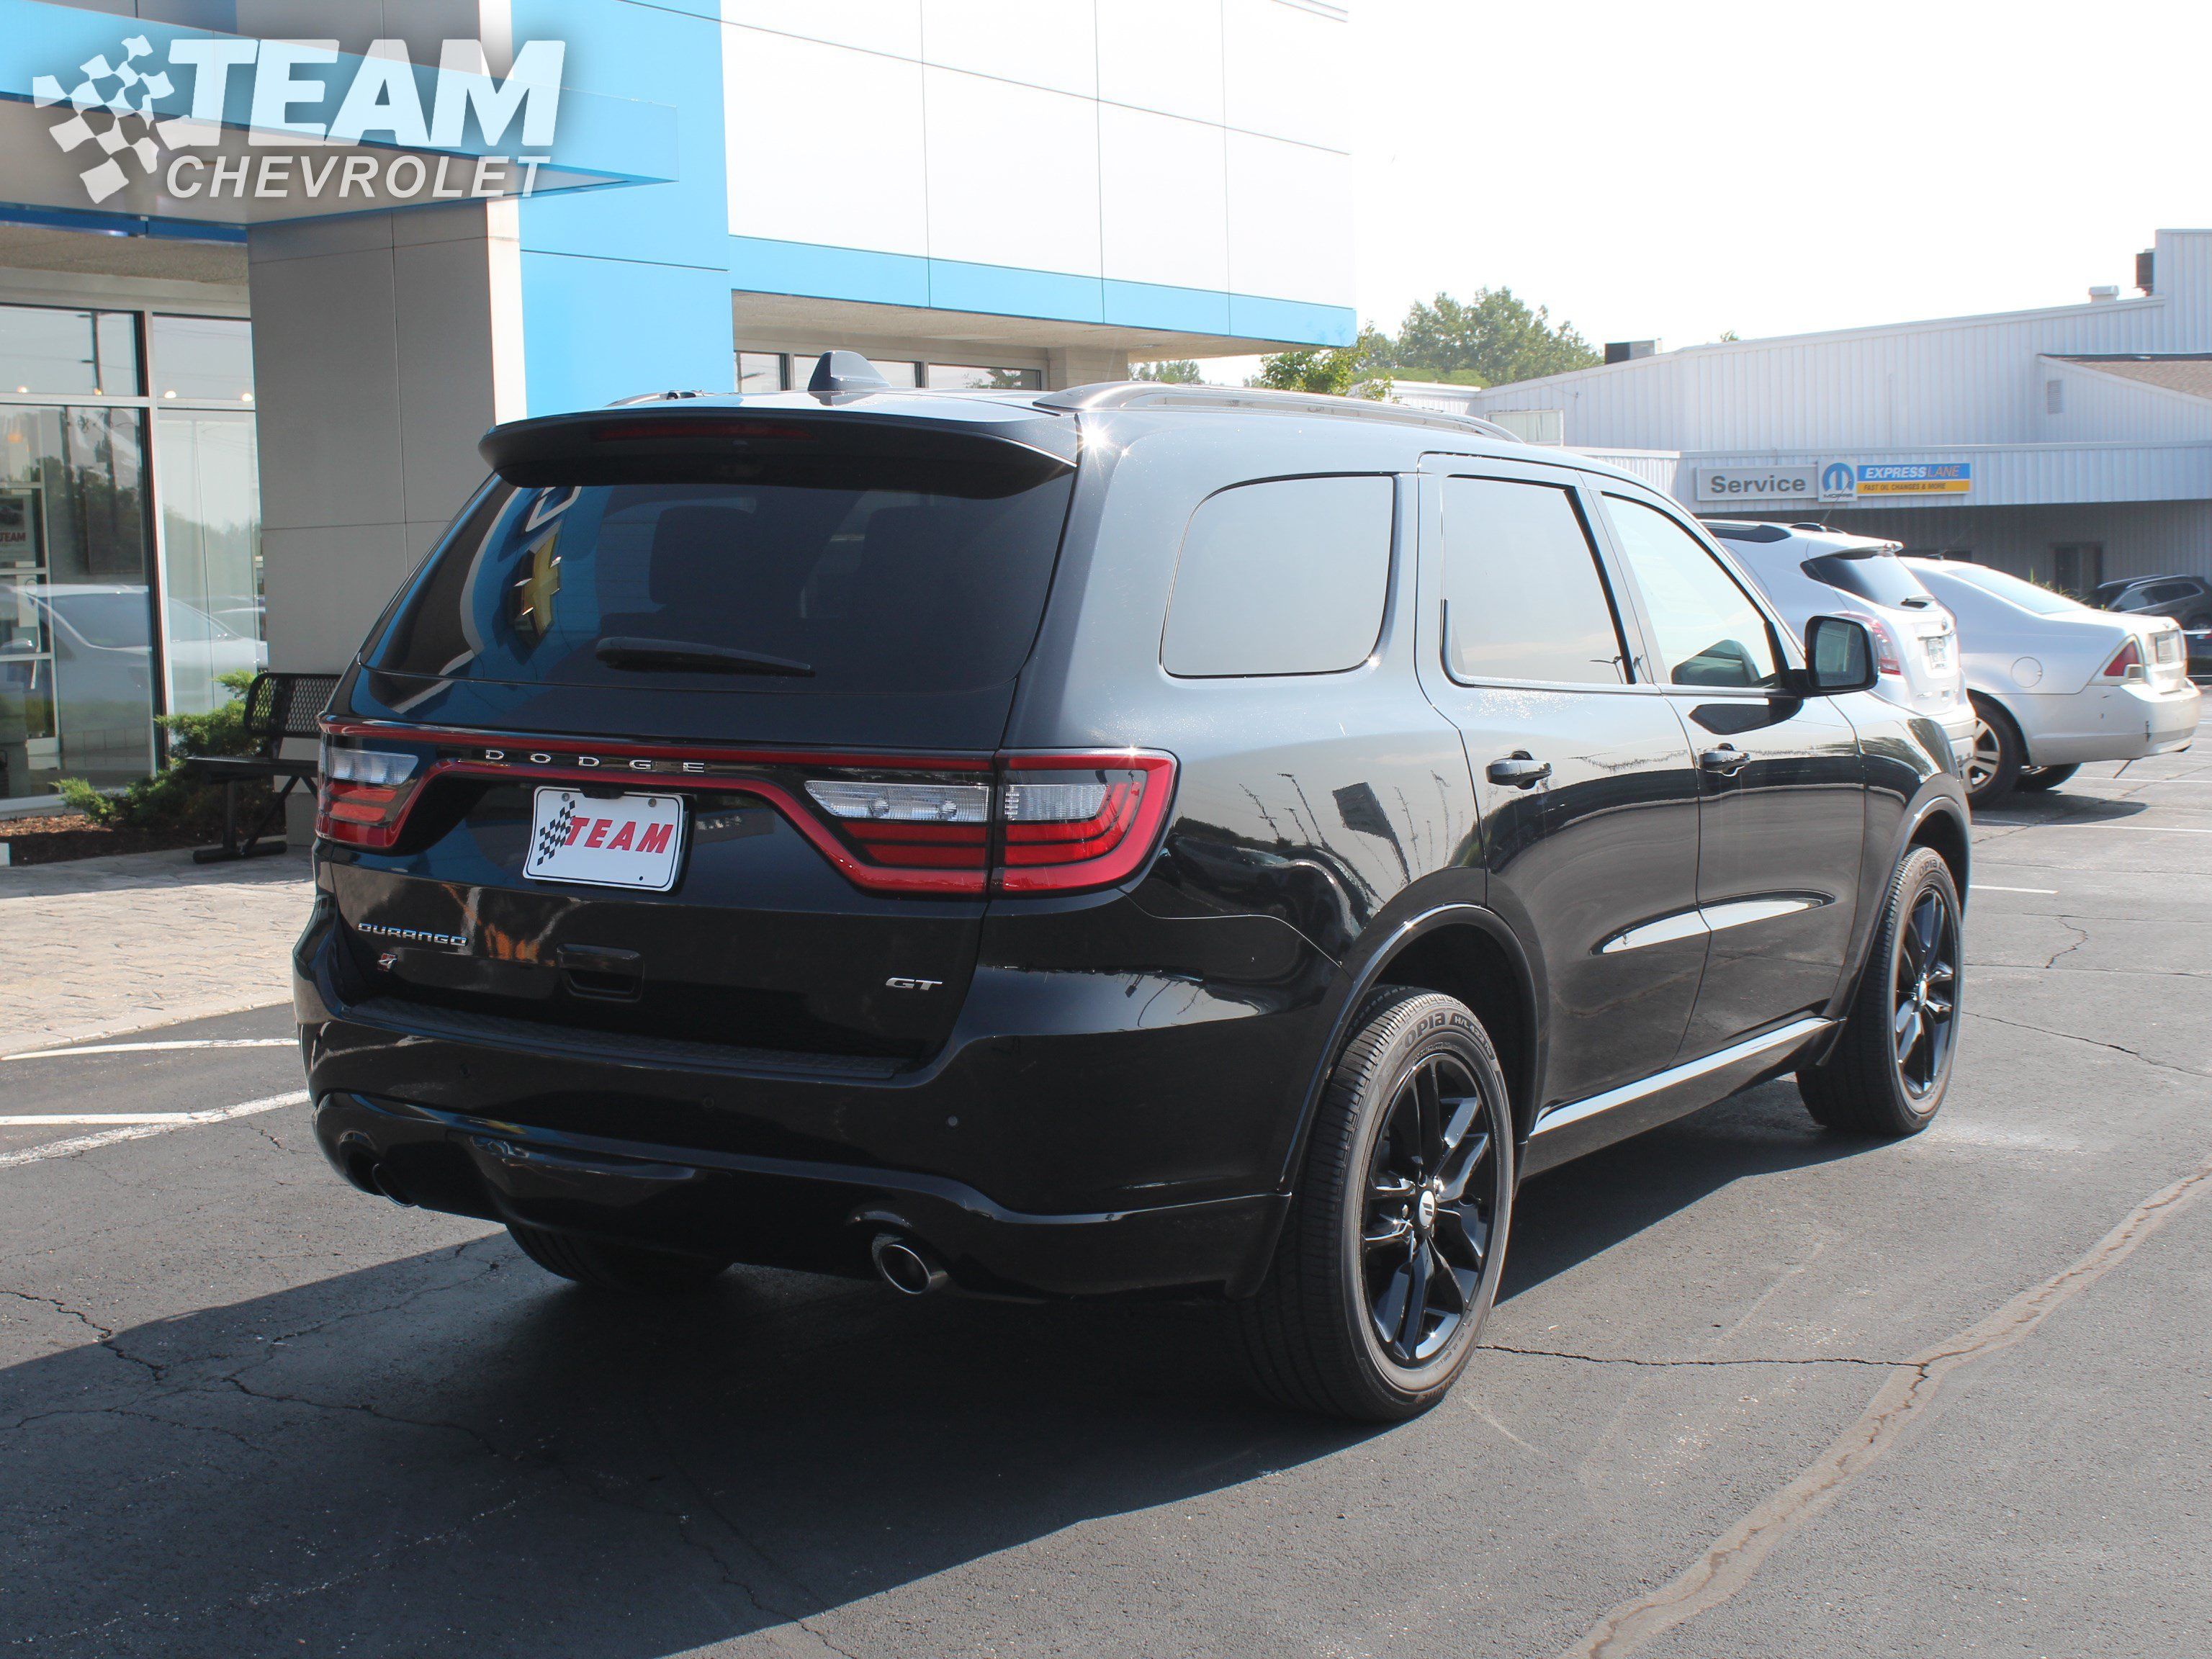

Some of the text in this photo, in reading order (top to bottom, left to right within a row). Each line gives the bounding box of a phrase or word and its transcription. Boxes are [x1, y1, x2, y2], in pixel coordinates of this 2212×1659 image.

[1709, 474, 1807, 494] Service
[485, 750, 705, 773] DODGE
[564, 816, 674, 854] TEAM
[358, 922, 467, 947] DURANGO
[885, 977, 943, 991] GT
